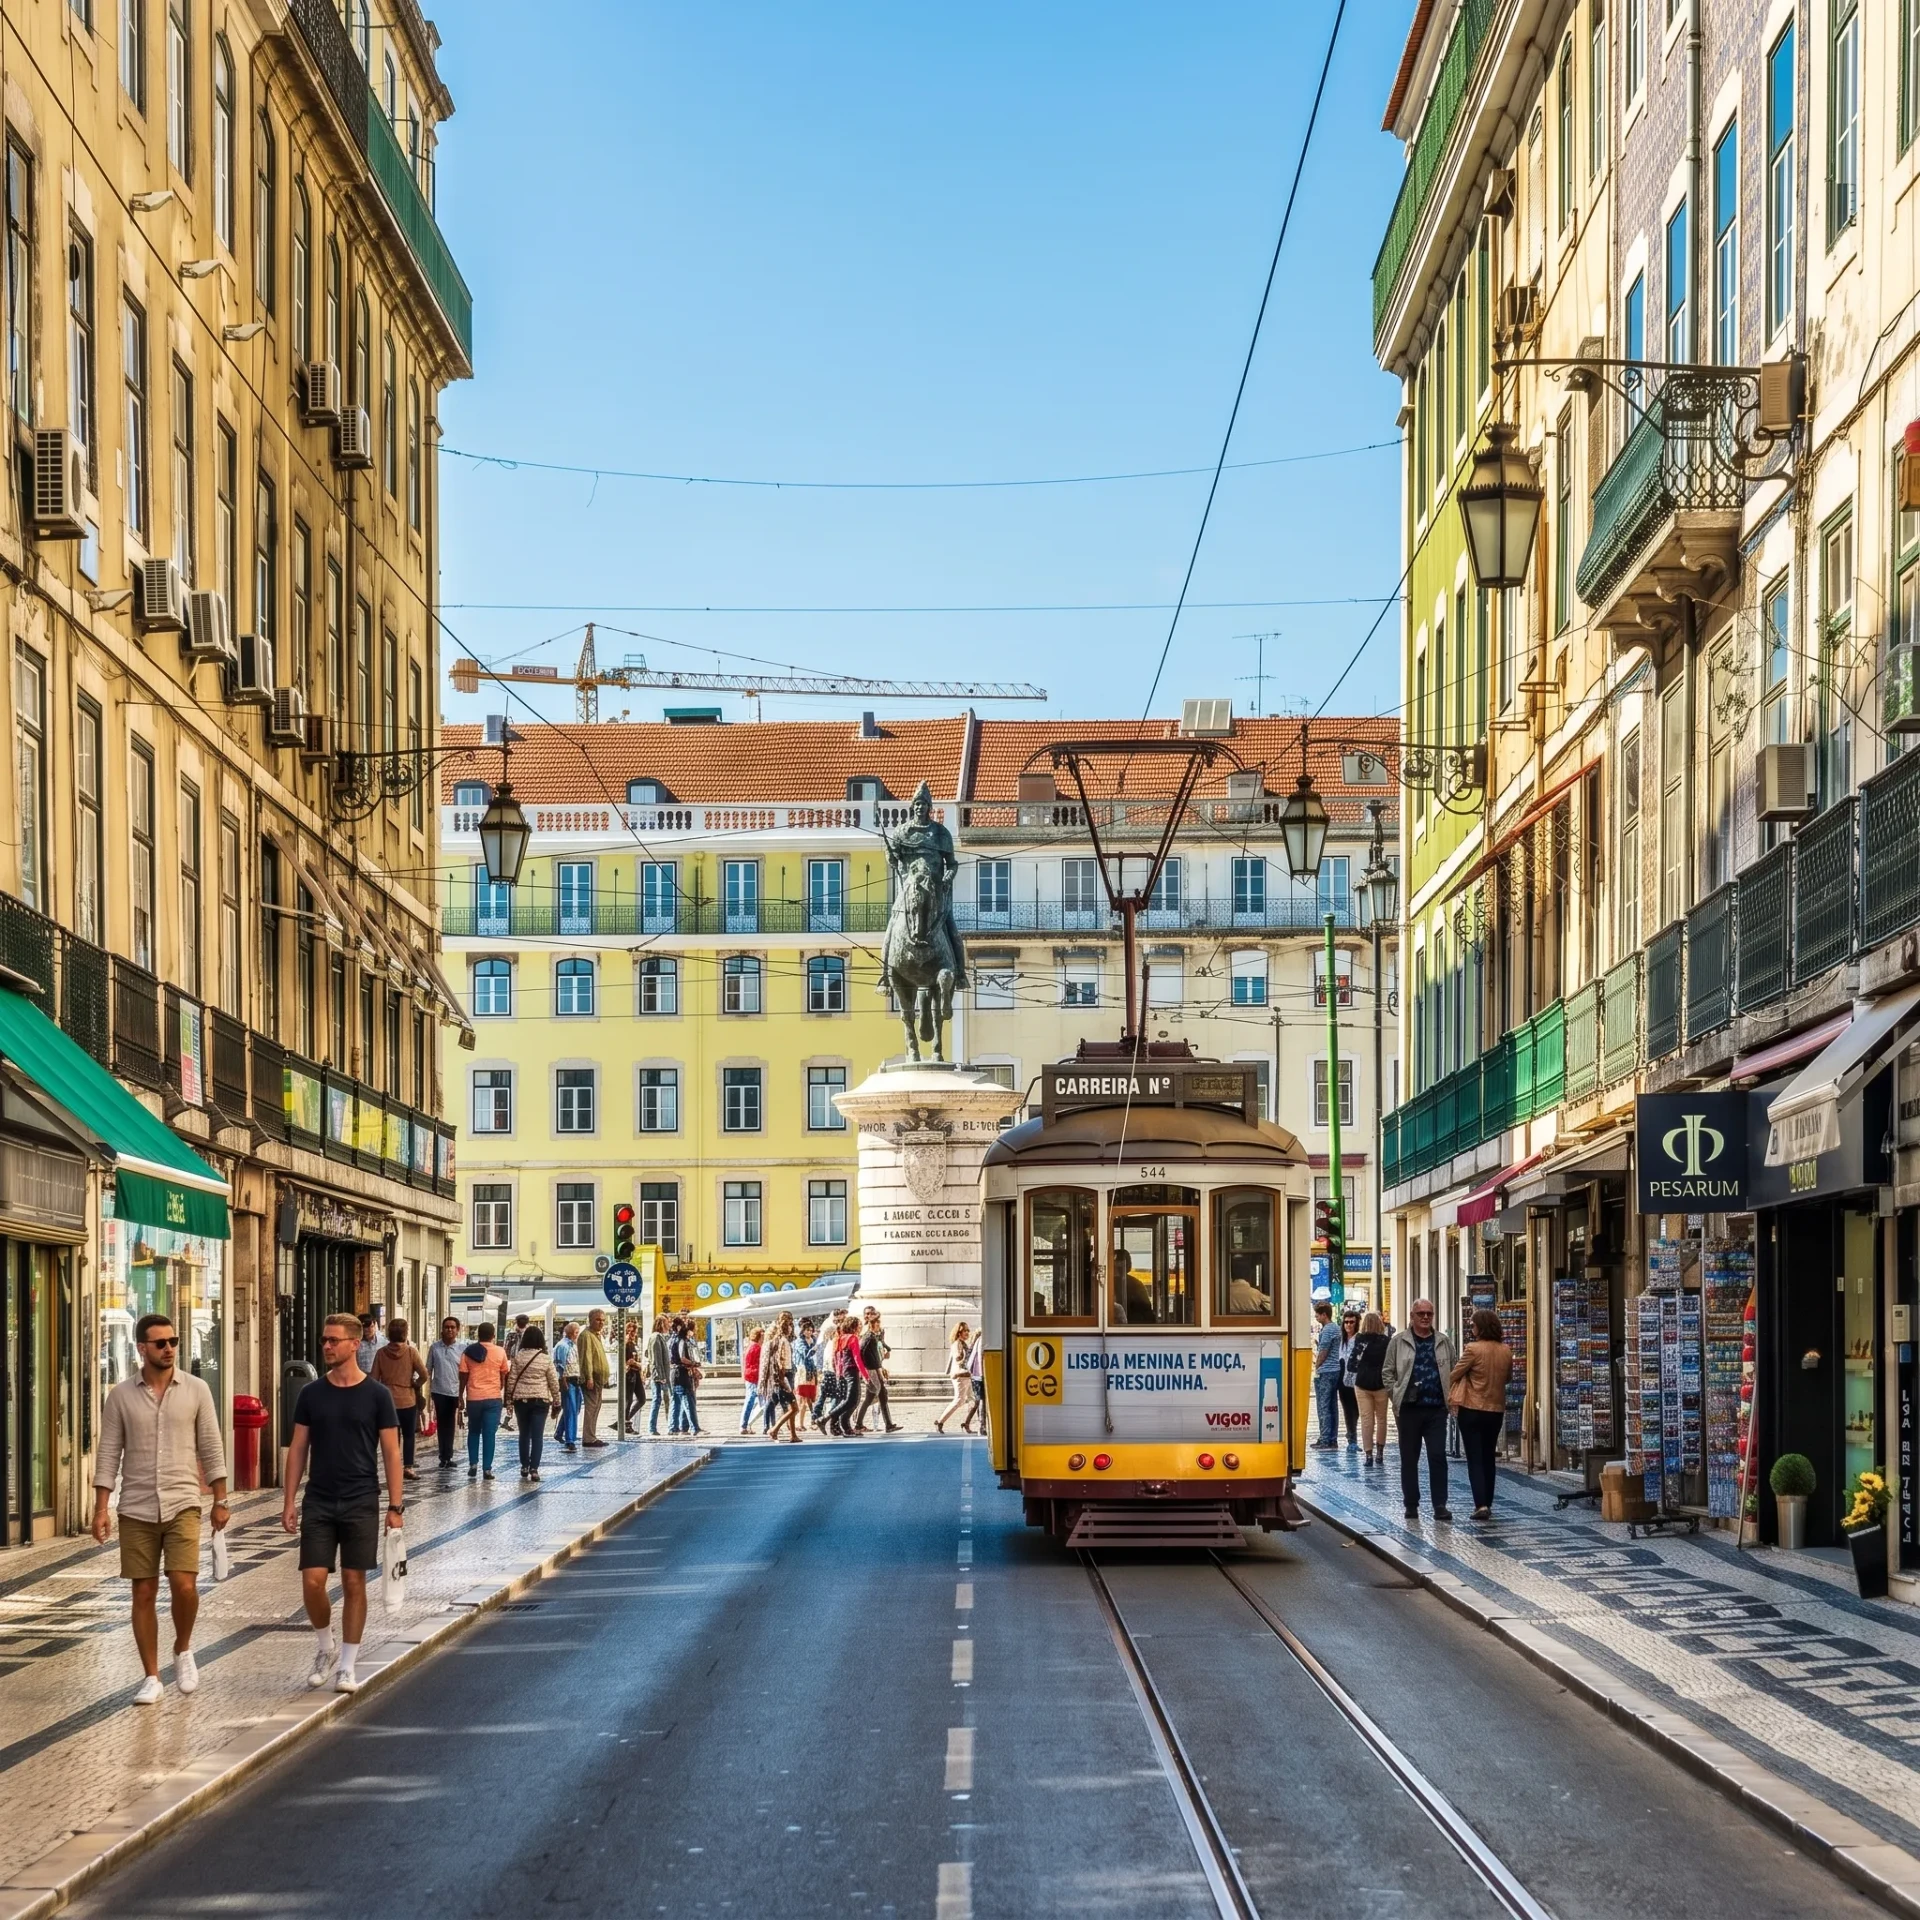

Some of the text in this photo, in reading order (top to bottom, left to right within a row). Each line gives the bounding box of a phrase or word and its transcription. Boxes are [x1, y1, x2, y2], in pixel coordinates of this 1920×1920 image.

[1055, 1077, 1140, 1095] CARREIRA
[1149, 1077, 1171, 1095] Nº
[1140, 1166, 1166, 1179] 544
[1650, 1180, 1739, 1197] PESARUM
[1067, 1353, 1246, 1372] LISBOA MENINA E MOÇA,
[1106, 1374, 1208, 1392] FRESQUINHA.
[1205, 1412, 1251, 1428] VIGOR
